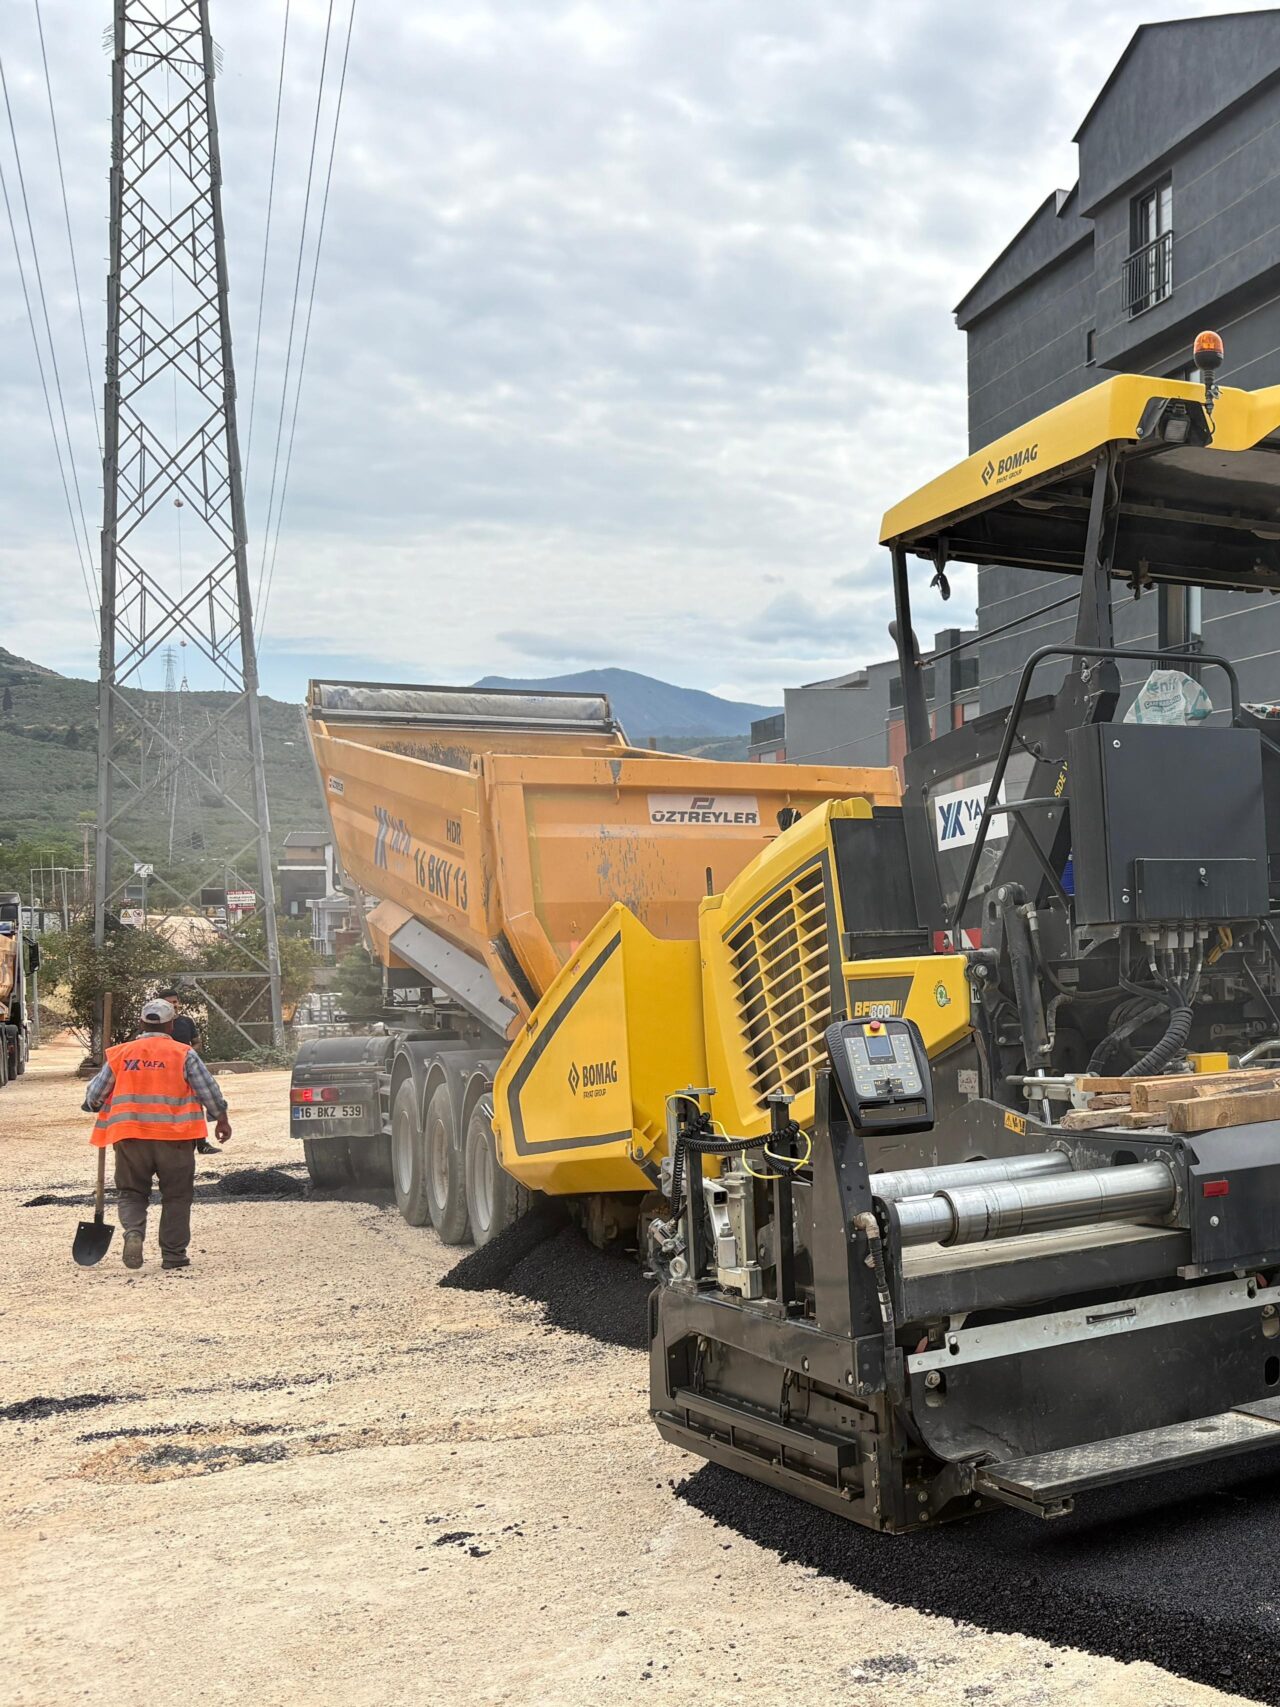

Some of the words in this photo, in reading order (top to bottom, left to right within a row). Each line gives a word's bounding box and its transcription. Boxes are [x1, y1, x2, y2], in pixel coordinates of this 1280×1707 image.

[997, 443, 1038, 476] BOMAG
[446, 818, 461, 846] HDR
[414, 848, 426, 888] 16
[428, 854, 452, 901] BKV
[454, 867, 467, 911] 13
[142, 1060, 165, 1069] YAFA
[582, 1060, 618, 1088] BOMAG
[300, 1107, 312, 1119] 16
[317, 1106, 336, 1118] BKZ
[342, 1105, 361, 1117] 539
